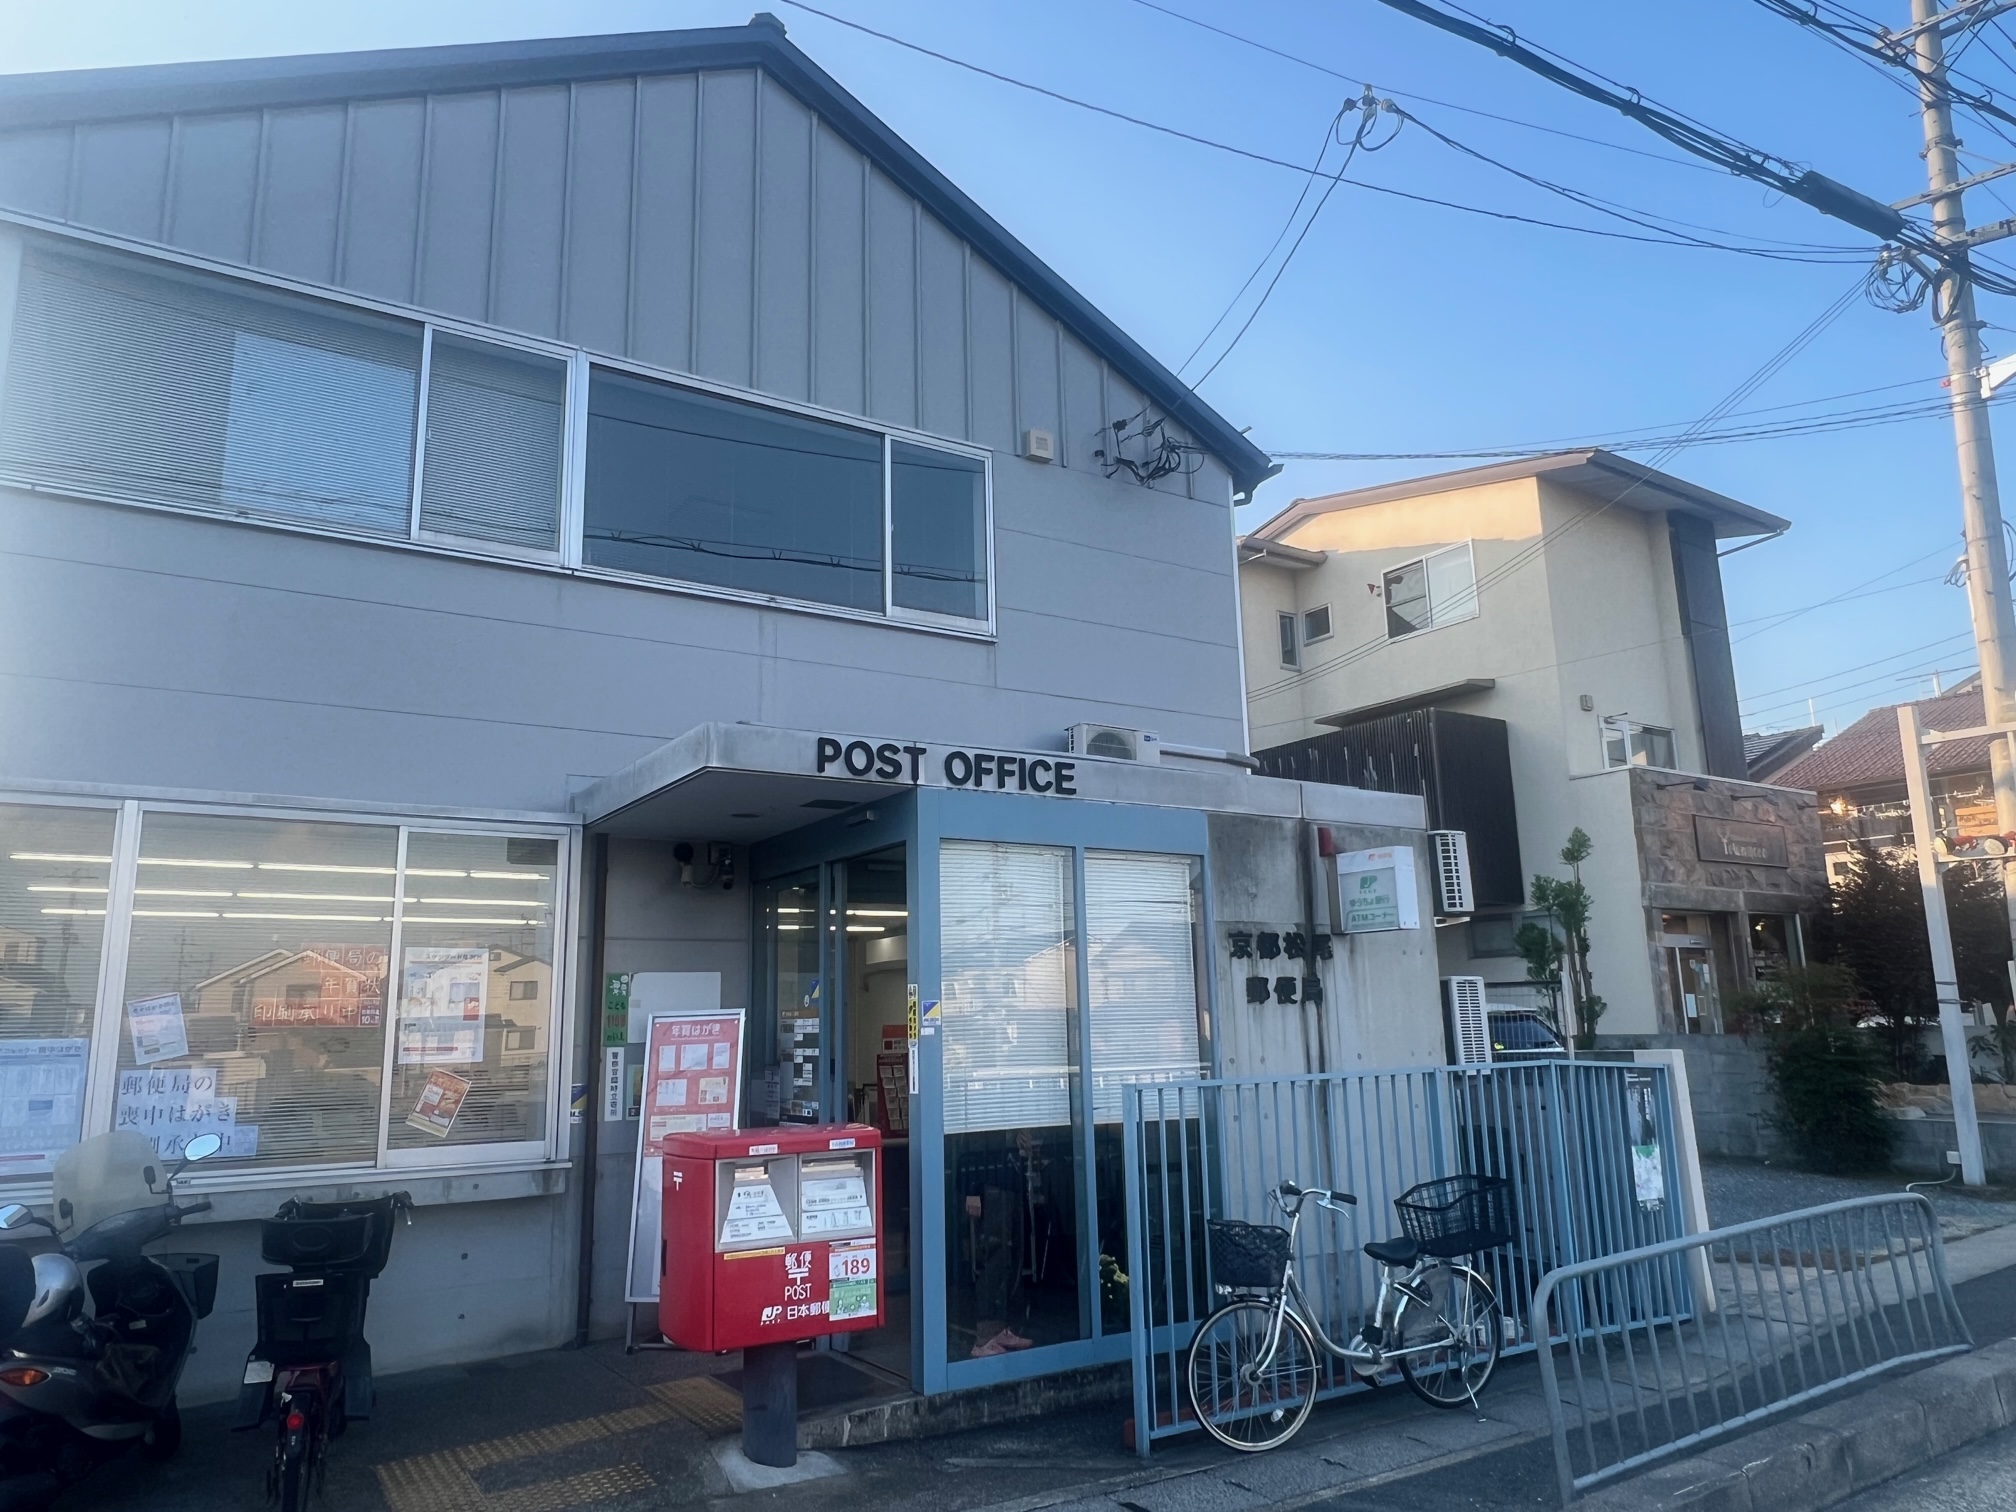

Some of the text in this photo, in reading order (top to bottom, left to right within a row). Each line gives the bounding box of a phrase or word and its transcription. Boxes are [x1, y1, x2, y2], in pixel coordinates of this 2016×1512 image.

[817, 737, 1077, 795] POST OFFICE
[322, 976, 380, 994] 年賀状
[254, 1004, 357, 1021] 印刷承り中
[672, 1023, 721, 1037] 年賀はがき
[121, 1075, 213, 1096] 郵便局の
[118, 1103, 231, 1126] 喪中はがき
[785, 1250, 812, 1270] 郵便
[842, 1257, 871, 1276] 189
[784, 1283, 812, 1301] POST
